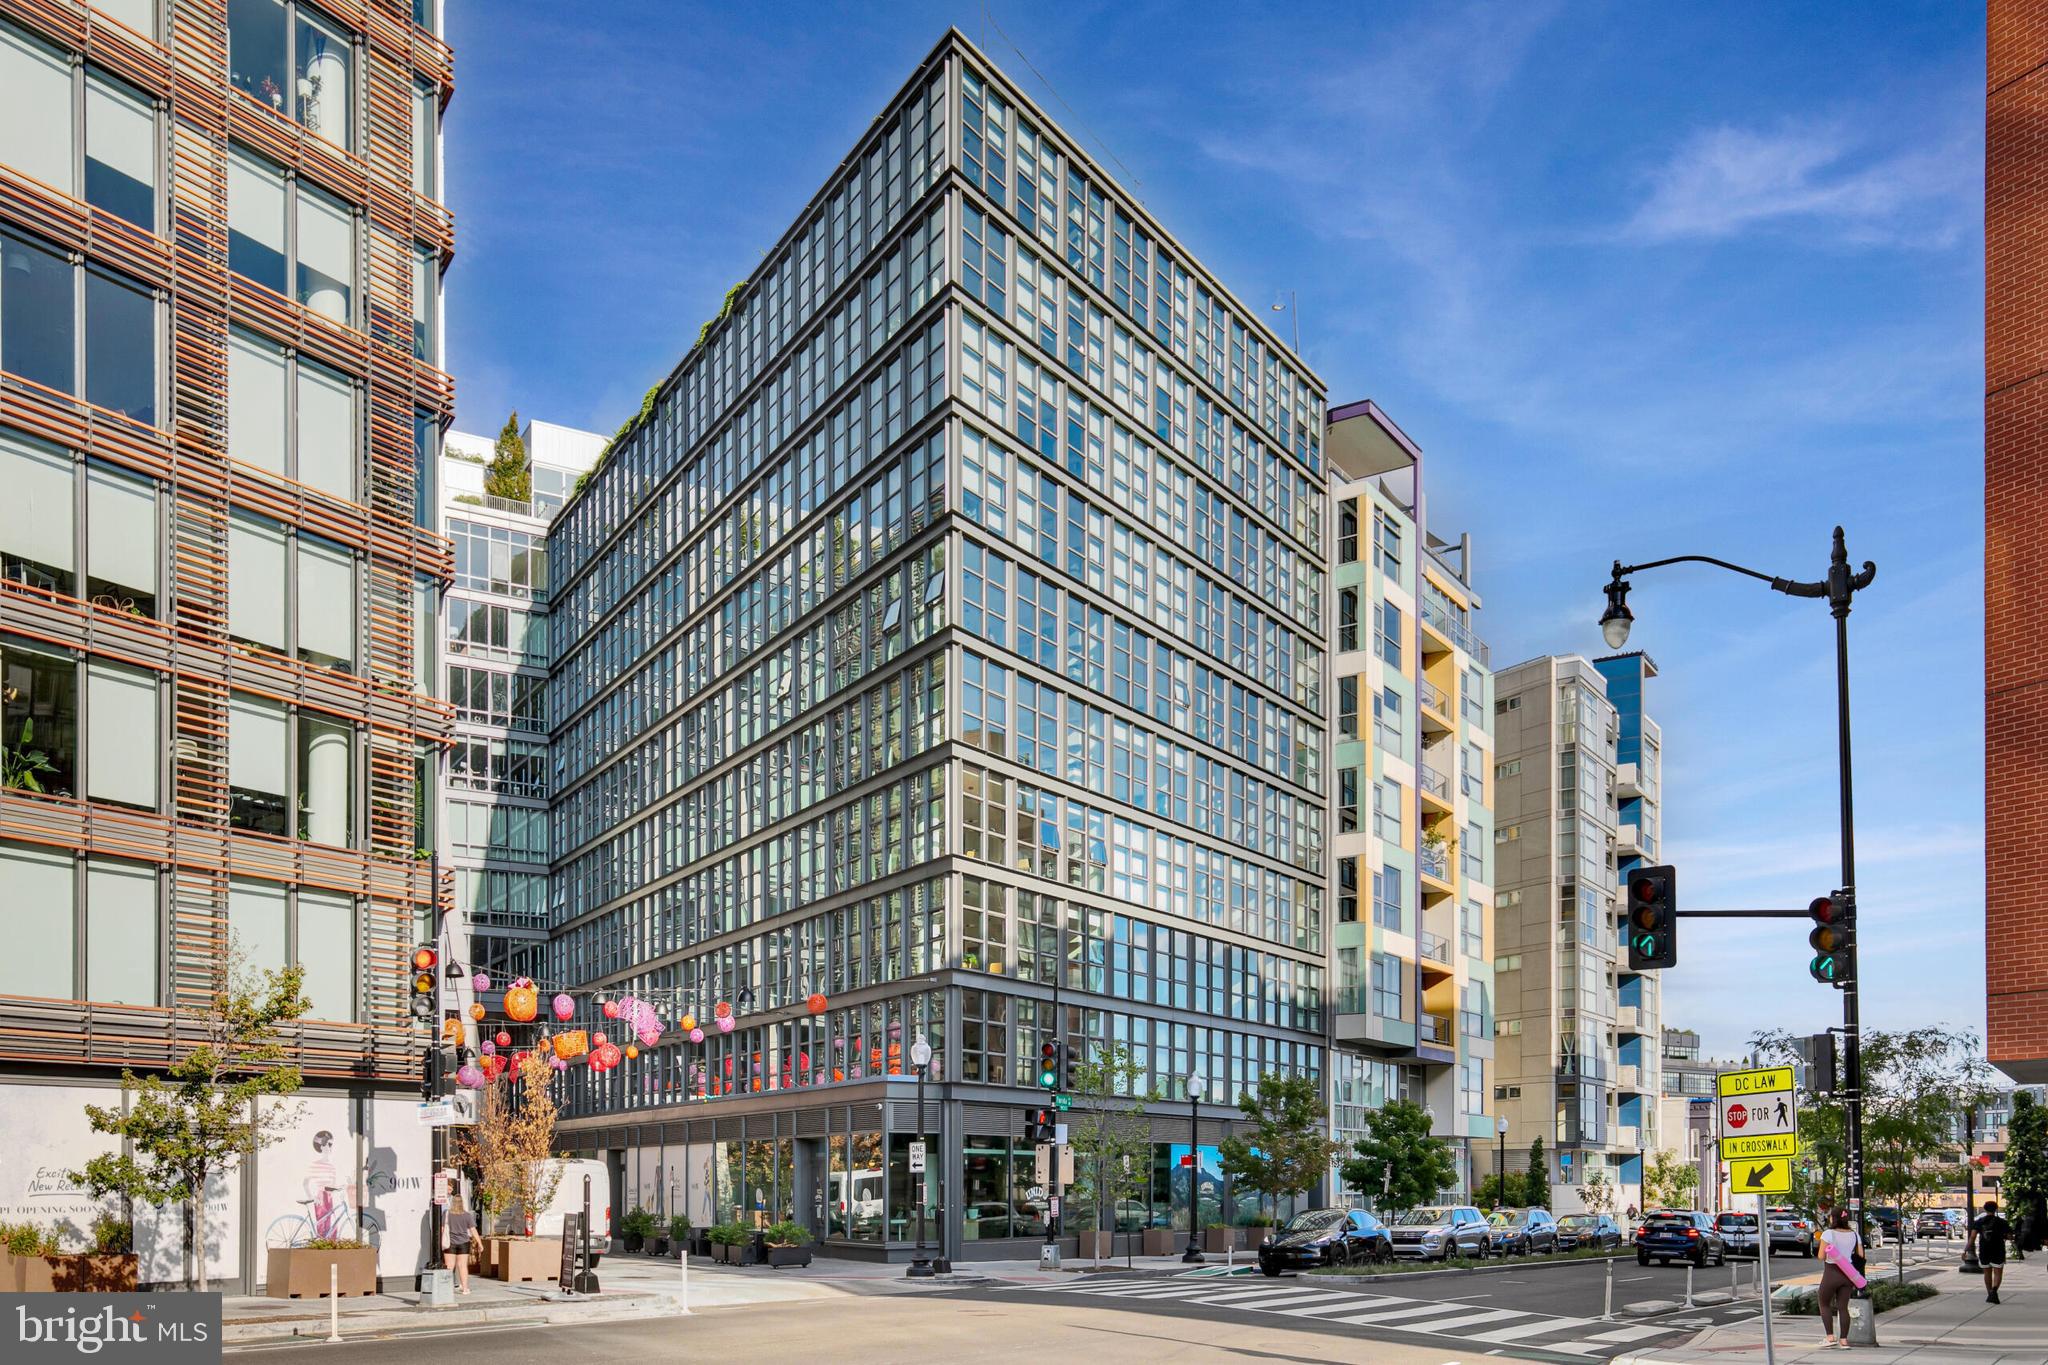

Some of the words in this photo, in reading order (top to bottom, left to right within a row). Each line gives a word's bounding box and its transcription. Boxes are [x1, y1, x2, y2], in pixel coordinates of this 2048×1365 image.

[1735, 1077, 1750, 1091] DC
[1754, 1075, 1776, 1089] LAW
[1728, 1110, 1747, 1121] STOP
[1751, 1107, 1770, 1121] FOR
[911, 1145, 924, 1153] ONE
[1729, 1142, 1738, 1154] IN
[1741, 1138, 1788, 1153] CROSSWALK
[911, 1153, 924, 1161] WAY
[28, 1179, 53, 1193] New
